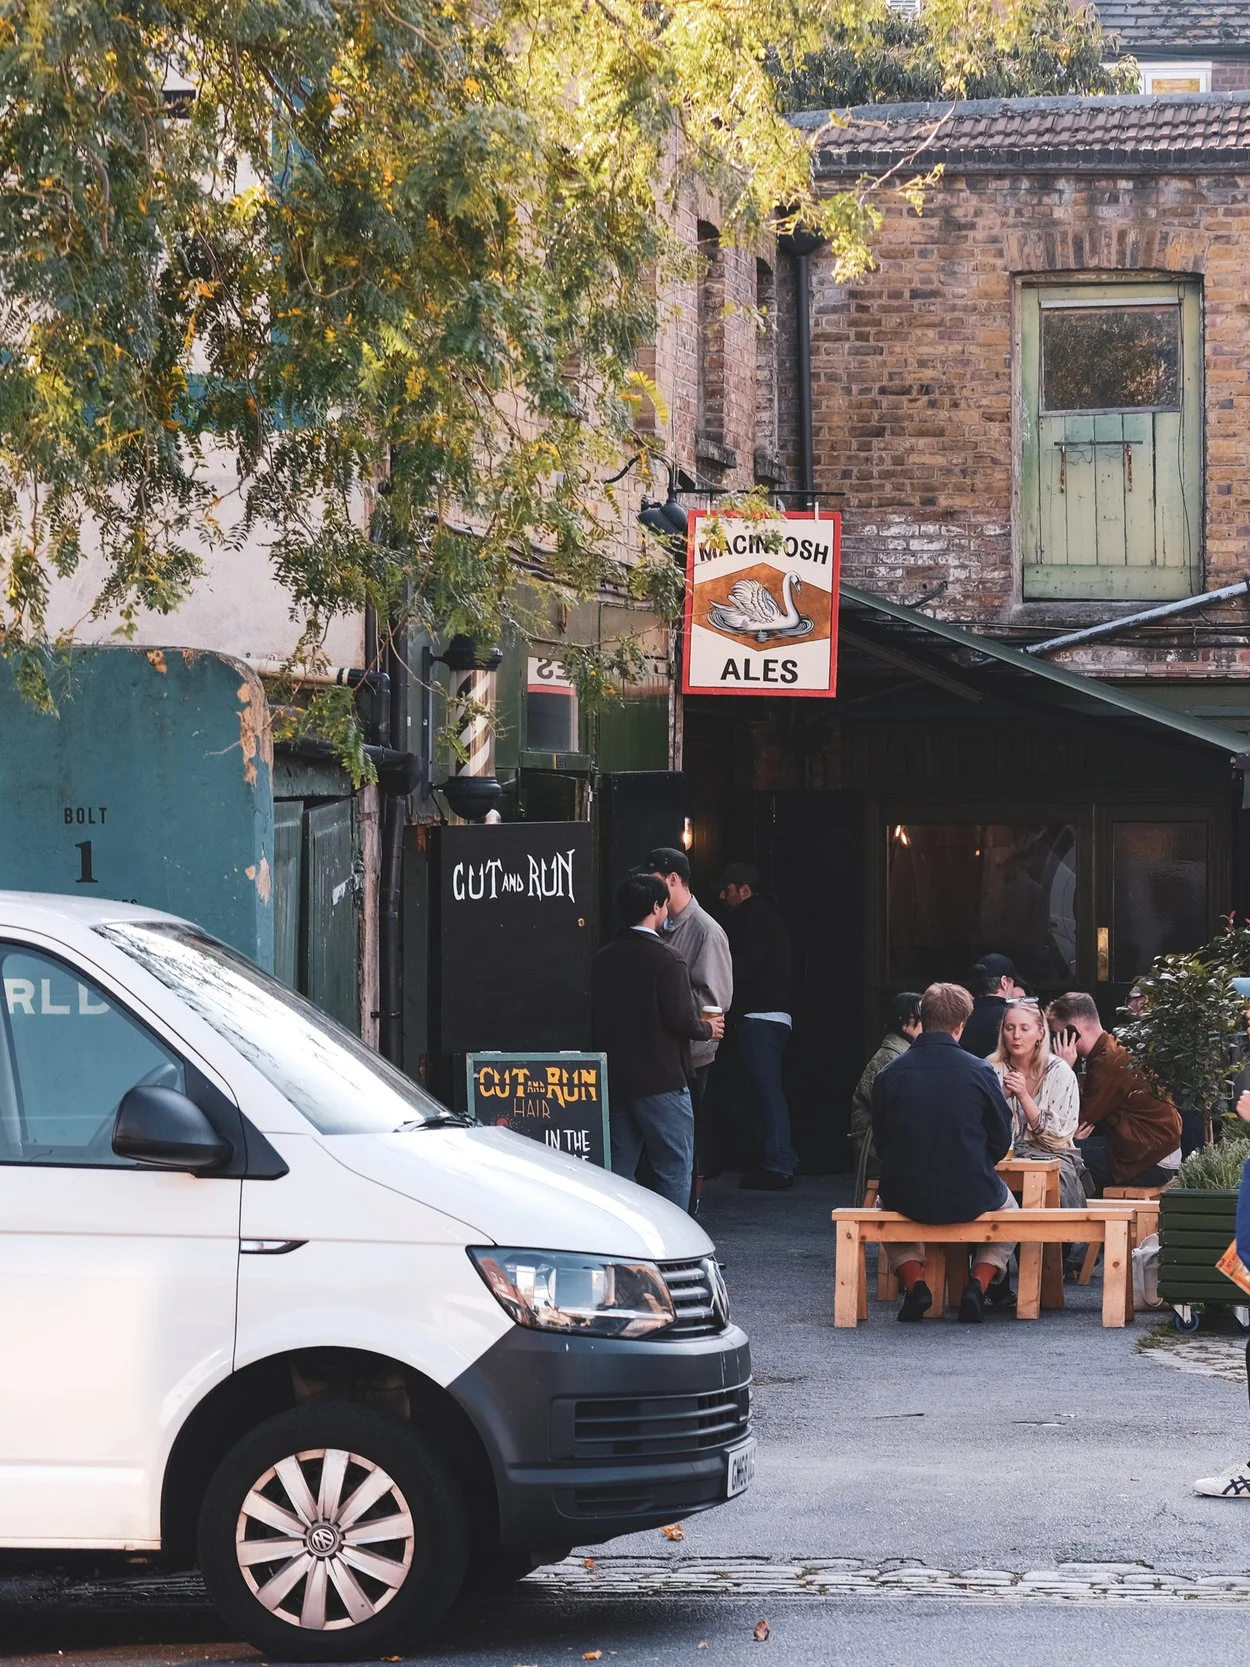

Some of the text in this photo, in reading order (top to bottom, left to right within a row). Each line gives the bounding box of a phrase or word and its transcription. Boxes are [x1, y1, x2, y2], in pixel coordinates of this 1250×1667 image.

[698, 534, 829, 565] MACINOSH
[720, 658, 798, 684] ALES
[64, 807, 107, 825] BOLT
[75, 840, 98, 884] 1
[453, 848, 576, 903] CUT AND RUN
[480, 1066, 598, 1109] CUT AND RUN
[513, 1098, 551, 1119] HAIR
[545, 1129, 591, 1153] IN THE
